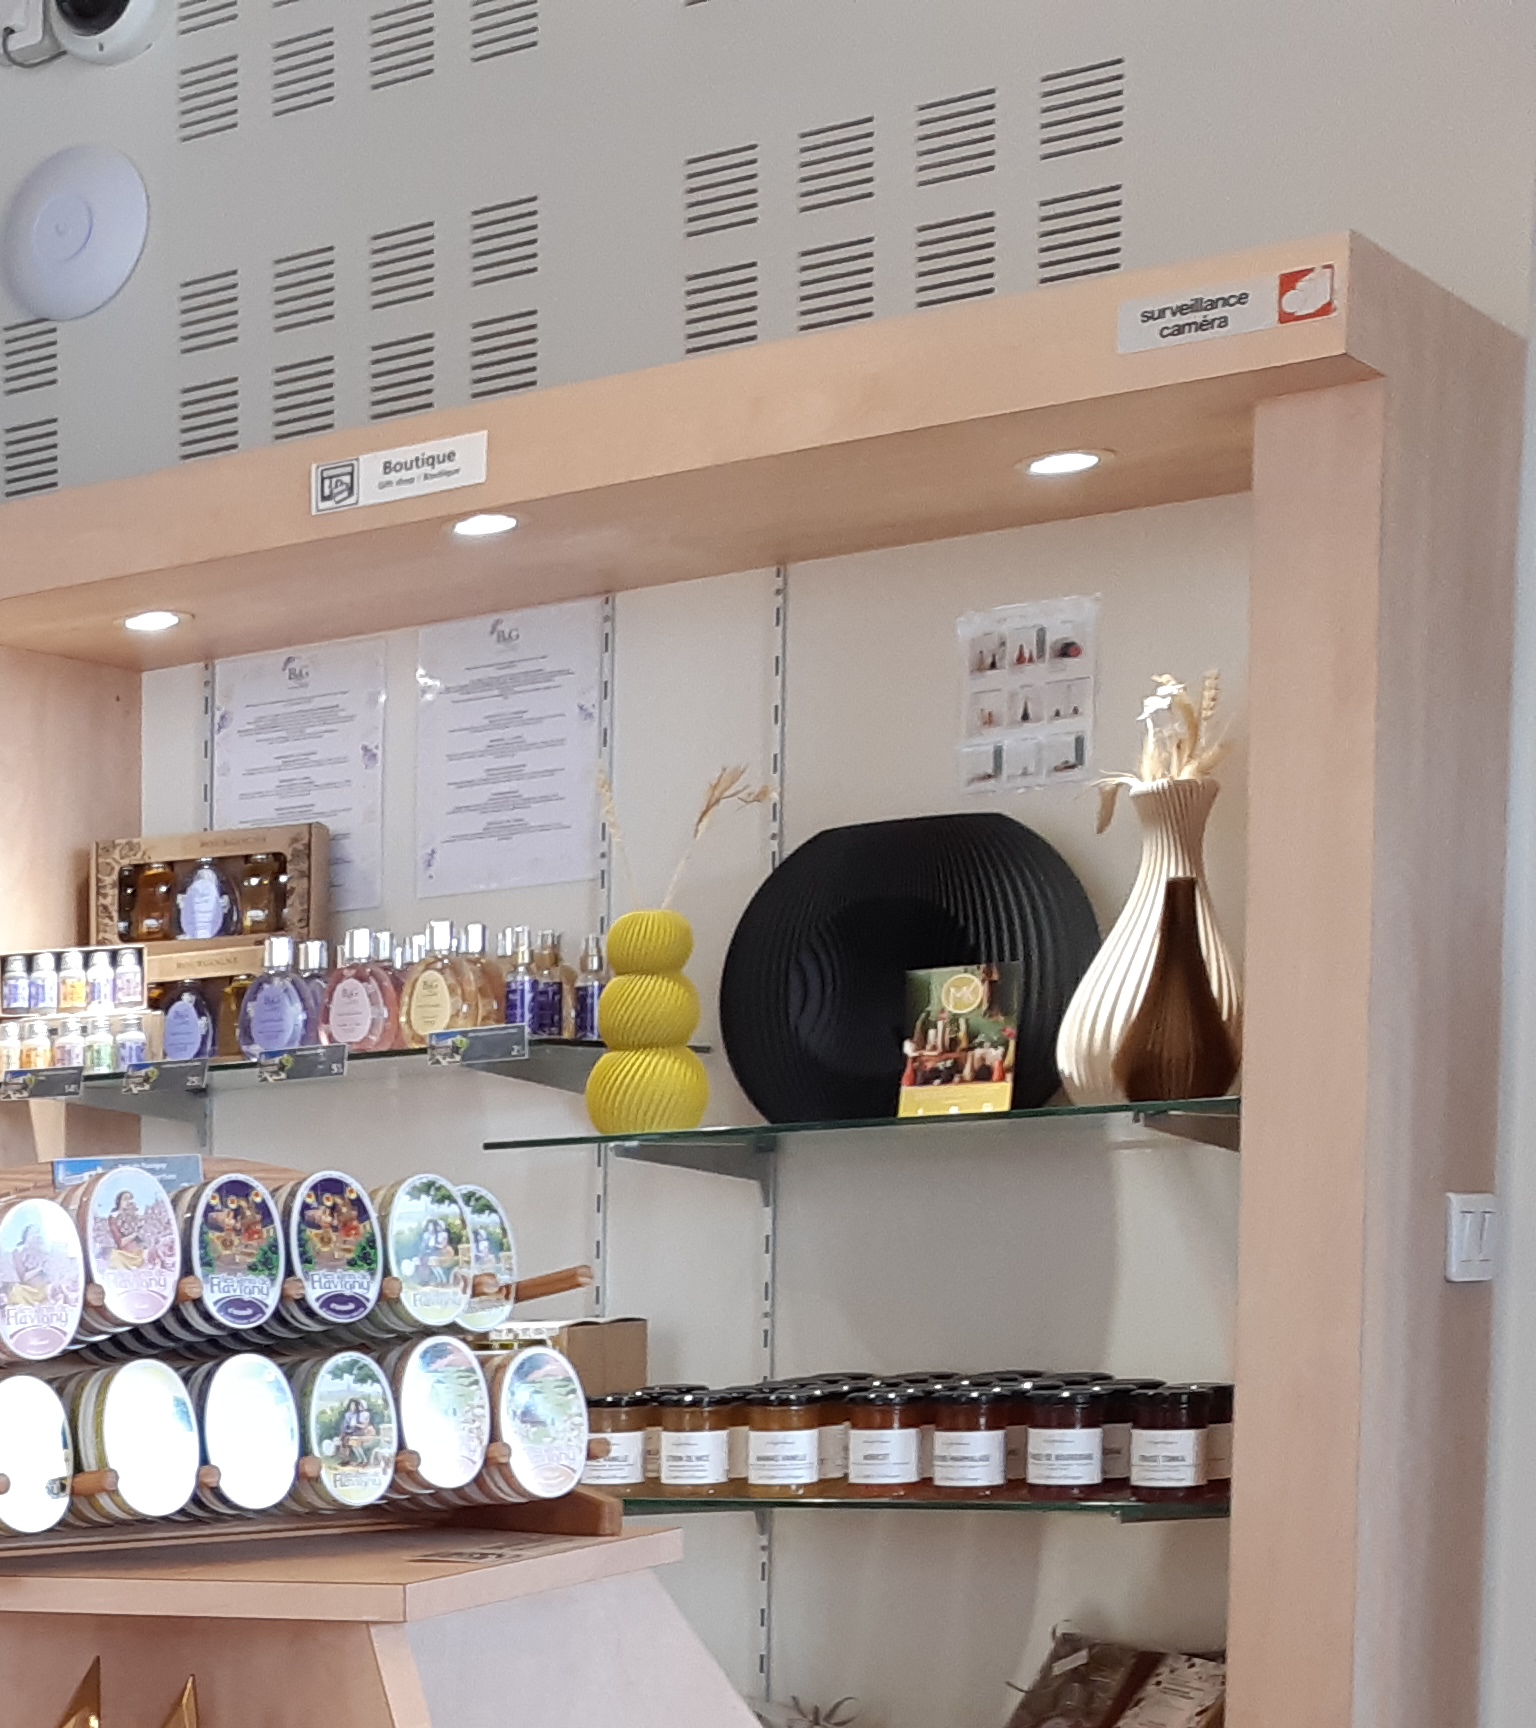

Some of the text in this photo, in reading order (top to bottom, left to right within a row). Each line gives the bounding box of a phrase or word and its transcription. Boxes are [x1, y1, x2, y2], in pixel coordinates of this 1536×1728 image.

[1140, 291, 1250, 323] surveillance
[1158, 315, 1229, 339] caméra
[382, 450, 457, 476] Boutique
[209, 1277, 271, 1297] Flavigny
[309, 1275, 371, 1294] Flavigny
